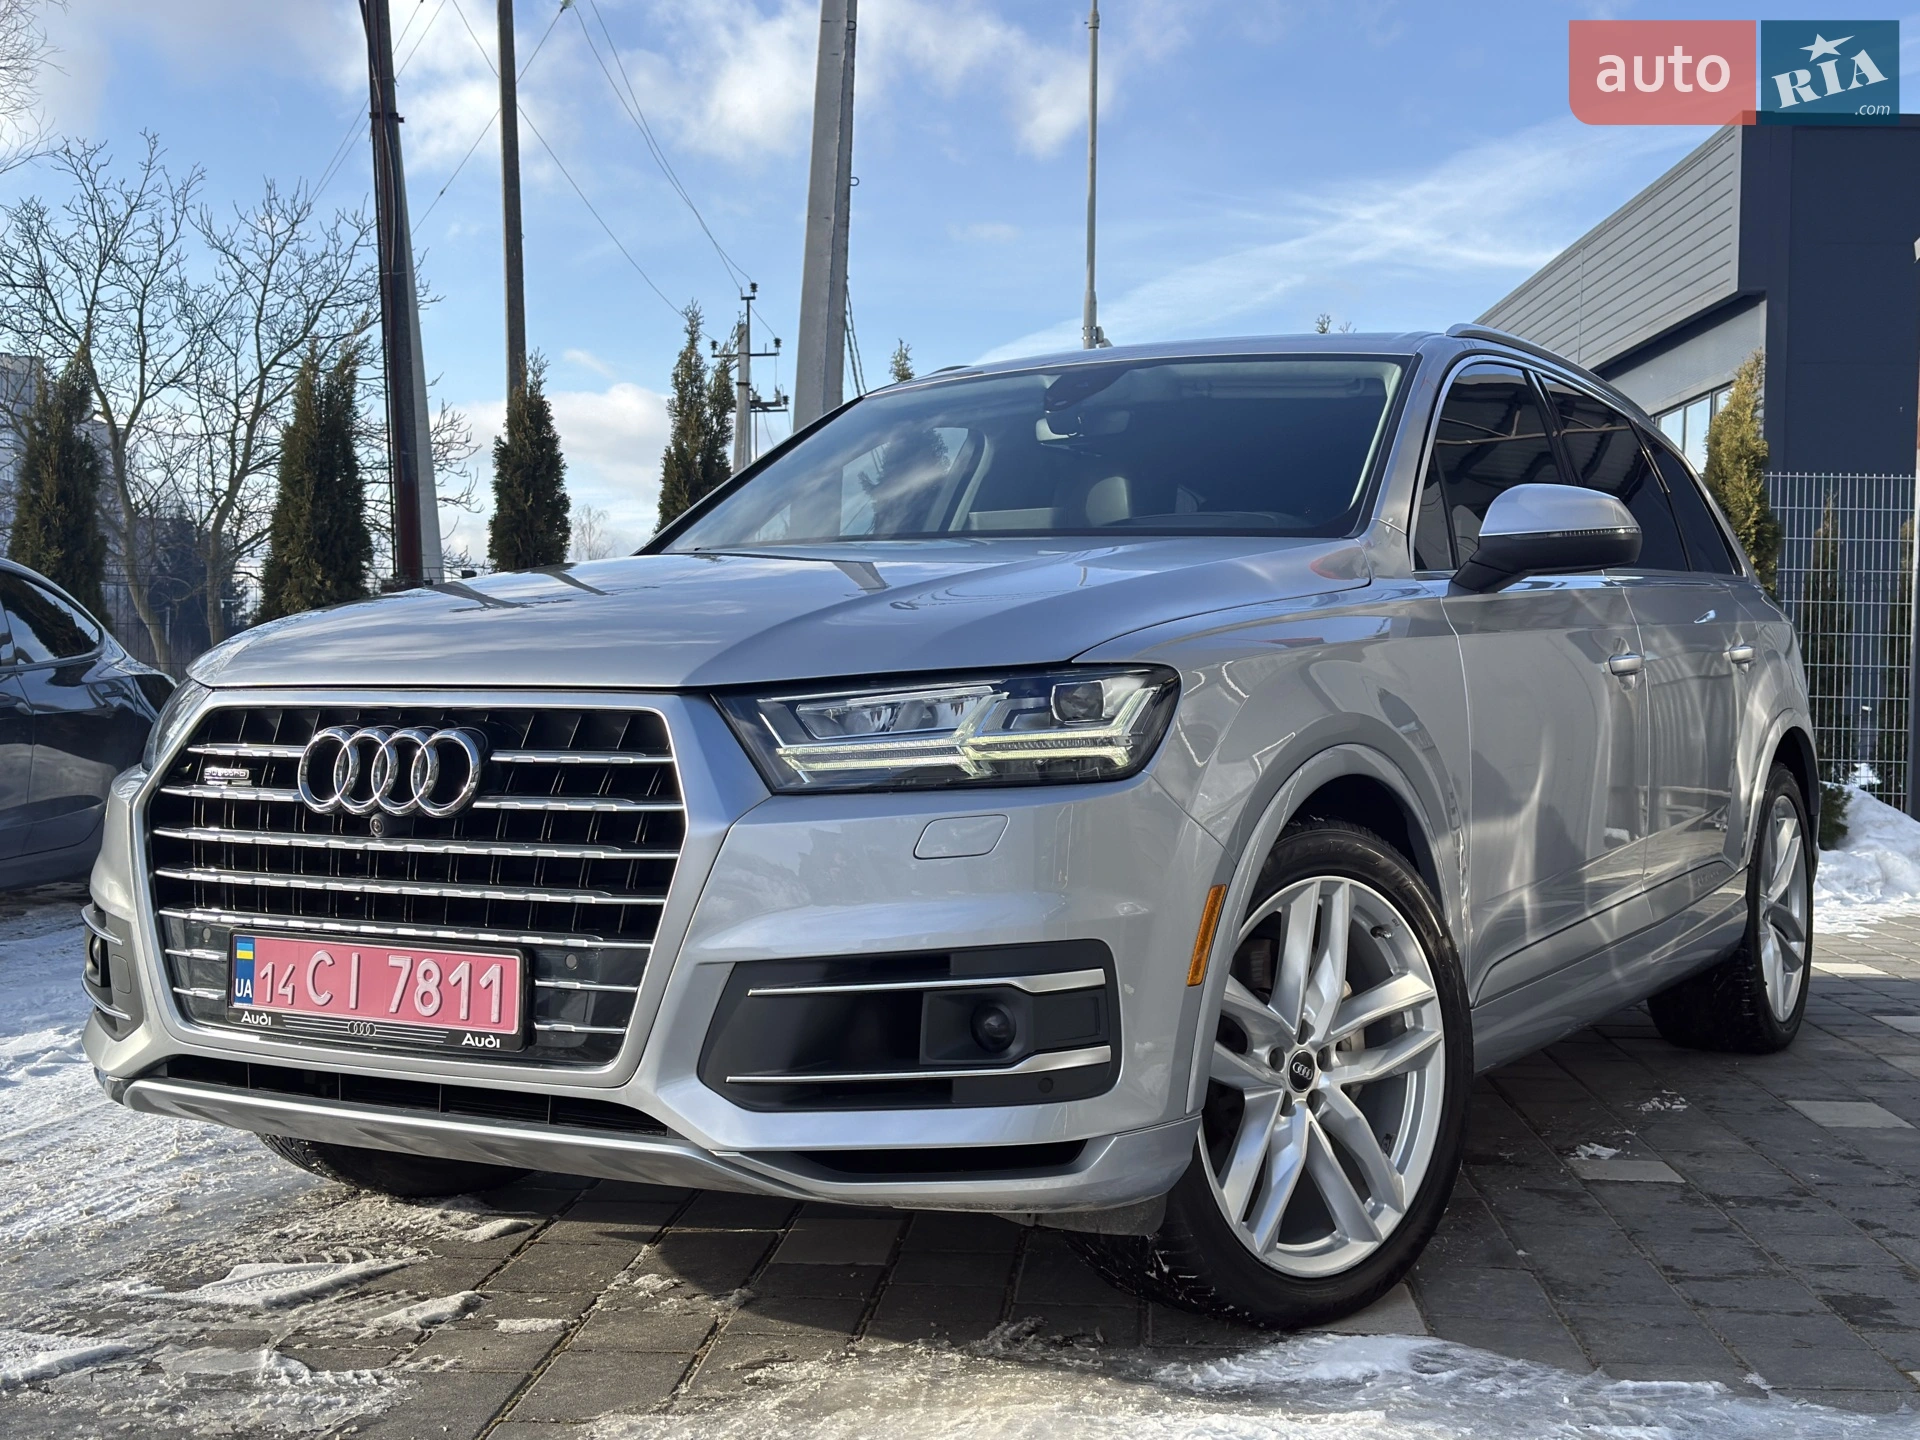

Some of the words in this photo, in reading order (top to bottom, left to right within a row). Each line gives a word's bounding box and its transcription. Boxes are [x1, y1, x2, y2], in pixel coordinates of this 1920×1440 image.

[235, 978, 252, 998] UA
[389, 955, 502, 1023] 7811
[240, 1010, 272, 1026] Audi
[461, 1032, 501, 1048] Audi
